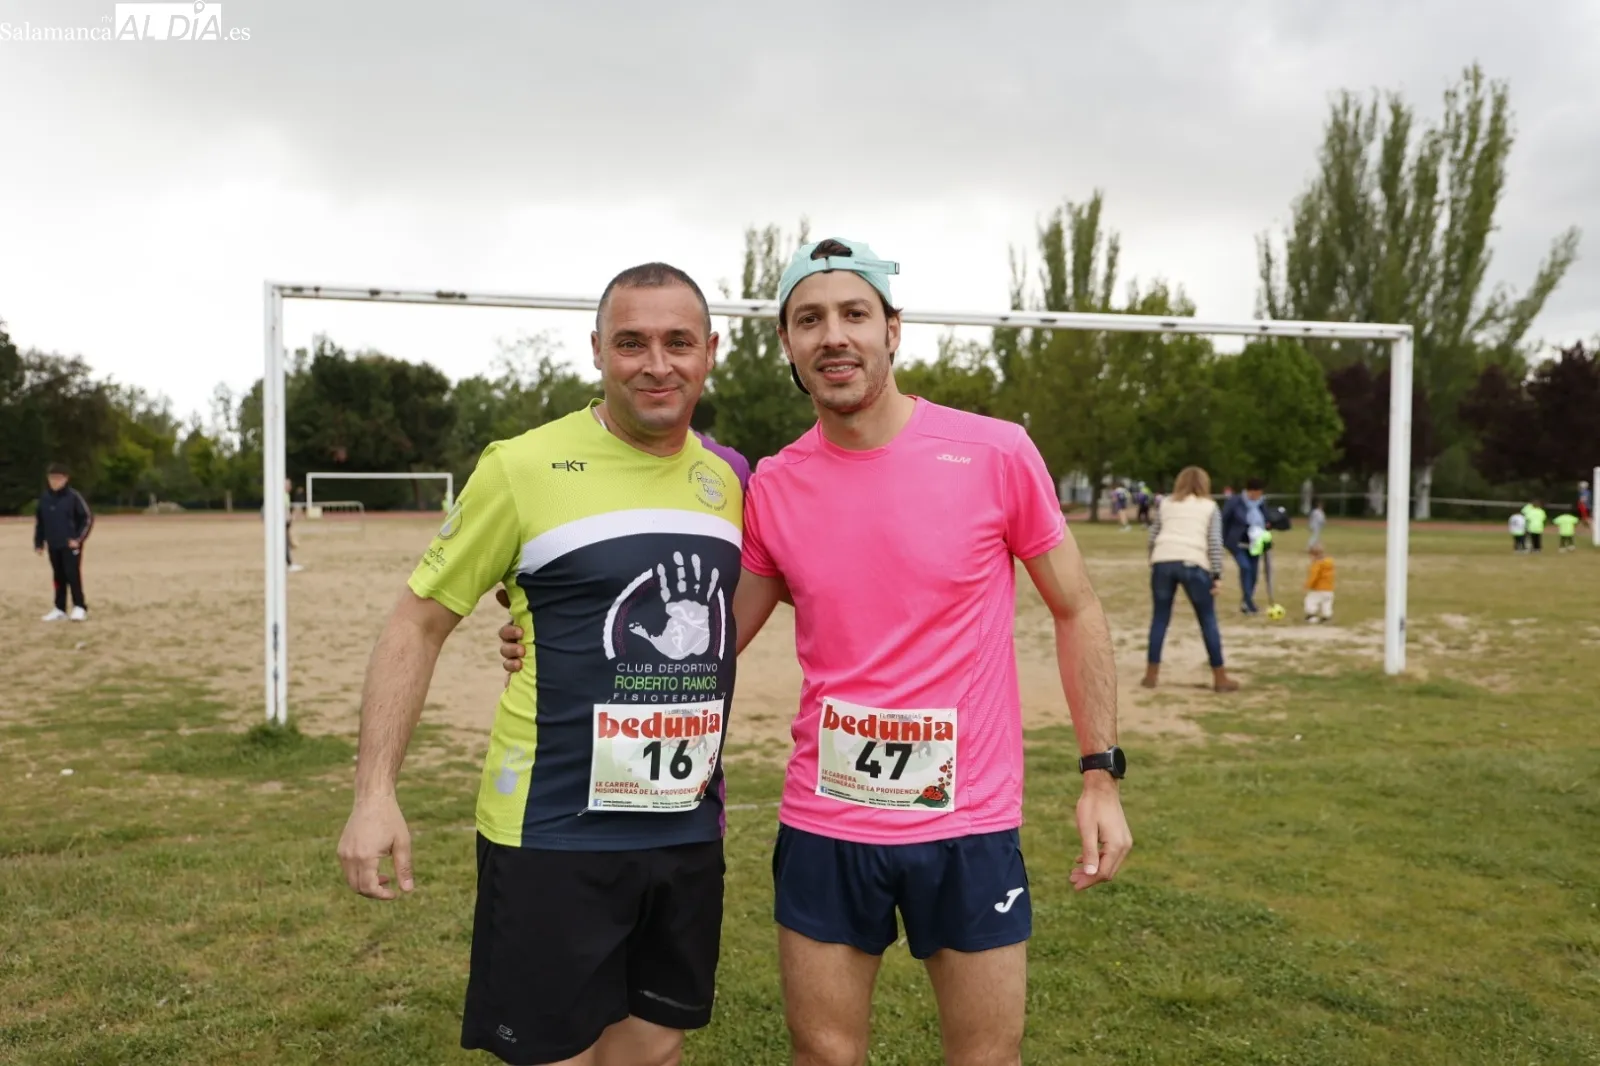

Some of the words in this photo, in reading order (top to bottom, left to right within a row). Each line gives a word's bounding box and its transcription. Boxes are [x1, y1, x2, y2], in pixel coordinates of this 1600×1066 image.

[551, 460, 588, 471] EKT
[616, 663, 653, 673] CLUB
[658, 663, 718, 673] DEPORTIVO
[614, 675, 679, 691] ROBERTO
[682, 675, 717, 690] RAMOS
[613, 692, 716, 702] FISIOTERAPIA
[597, 709, 720, 739] bedunia
[822, 704, 953, 741] bedunia
[643, 739, 693, 781] 16
[855, 741, 913, 780] 47
[828, 769, 857, 782] CARRERA
[594, 787, 638, 795] MISIONERAS
[660, 787, 698, 796] PROVIDENCIA
[821, 775, 856, 789] MISIONERAS
[856, 783, 865, 791] DE
[866, 785, 875, 793] LA
[876, 785, 920, 795] PROVIDENCIA
